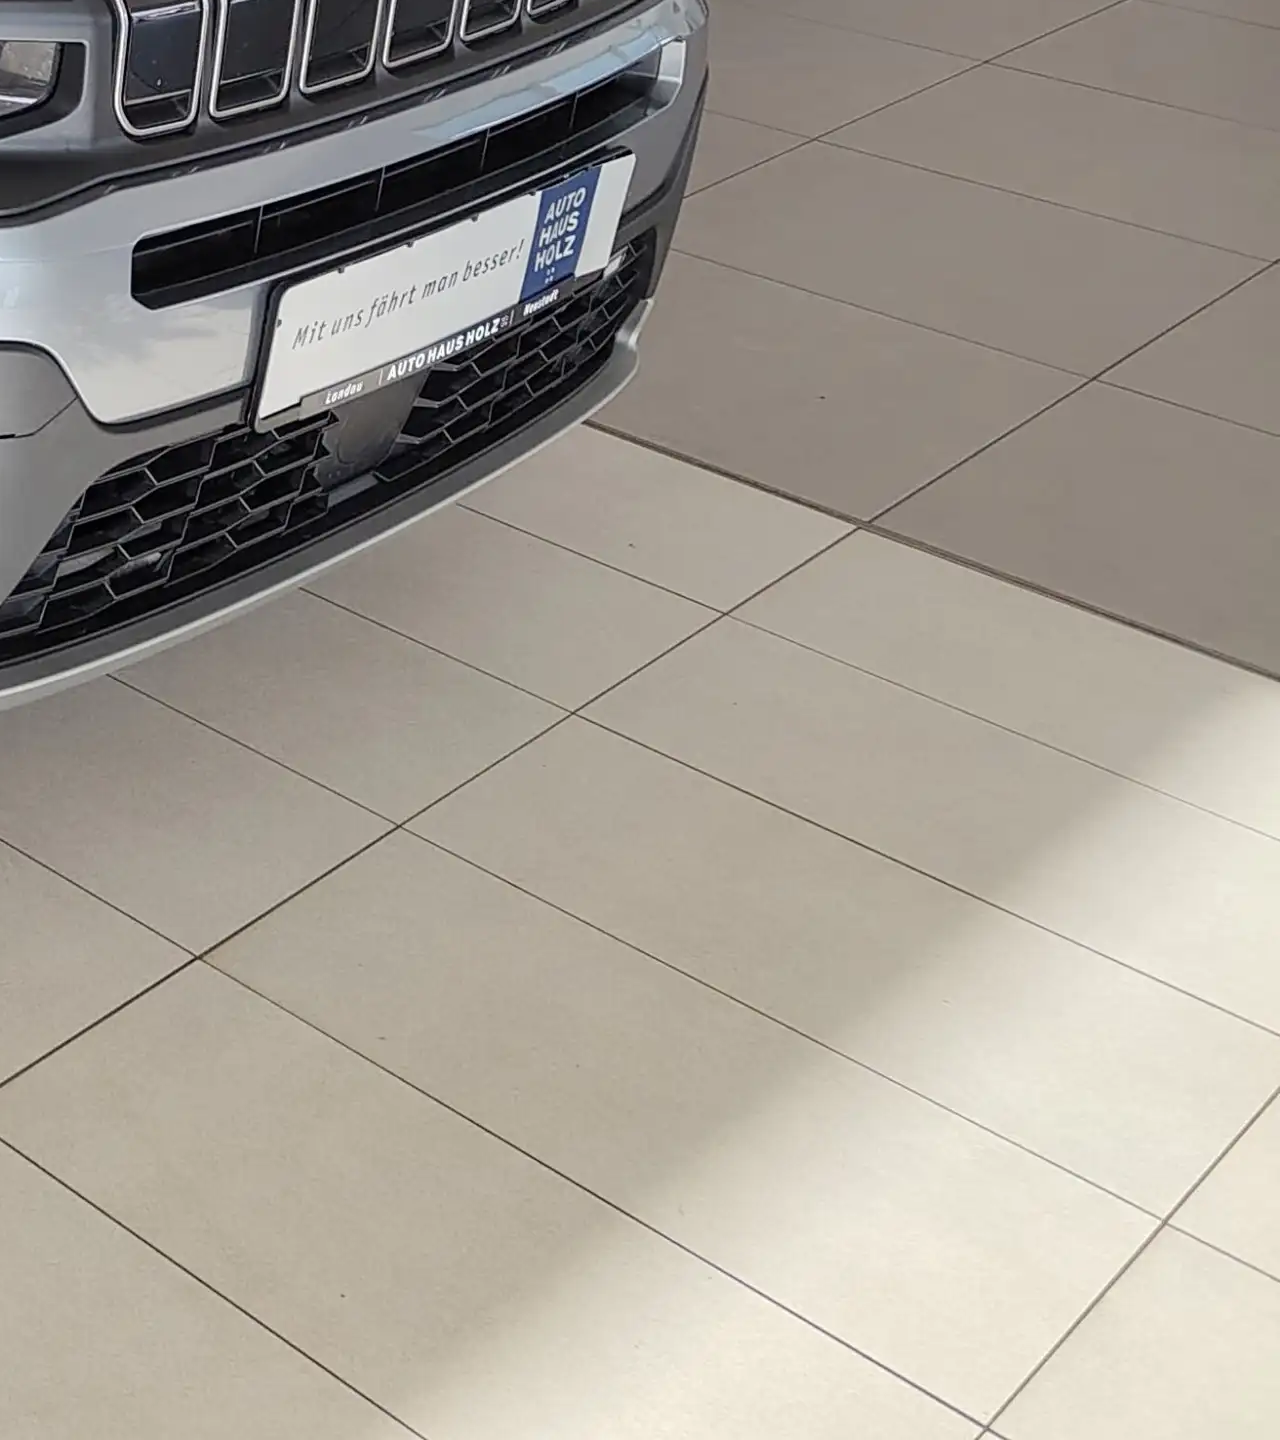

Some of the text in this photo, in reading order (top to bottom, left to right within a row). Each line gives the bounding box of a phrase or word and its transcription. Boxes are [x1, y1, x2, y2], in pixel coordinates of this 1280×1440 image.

[544, 186, 587, 224] AUTO
[539, 210, 580, 248] HAUS
[534, 235, 576, 273] HOLZ
[292, 238, 525, 350] Mit uns fährt man besser!
[325, 288, 560, 405] Landau AUTO HAUS HOLZ Neustadt
